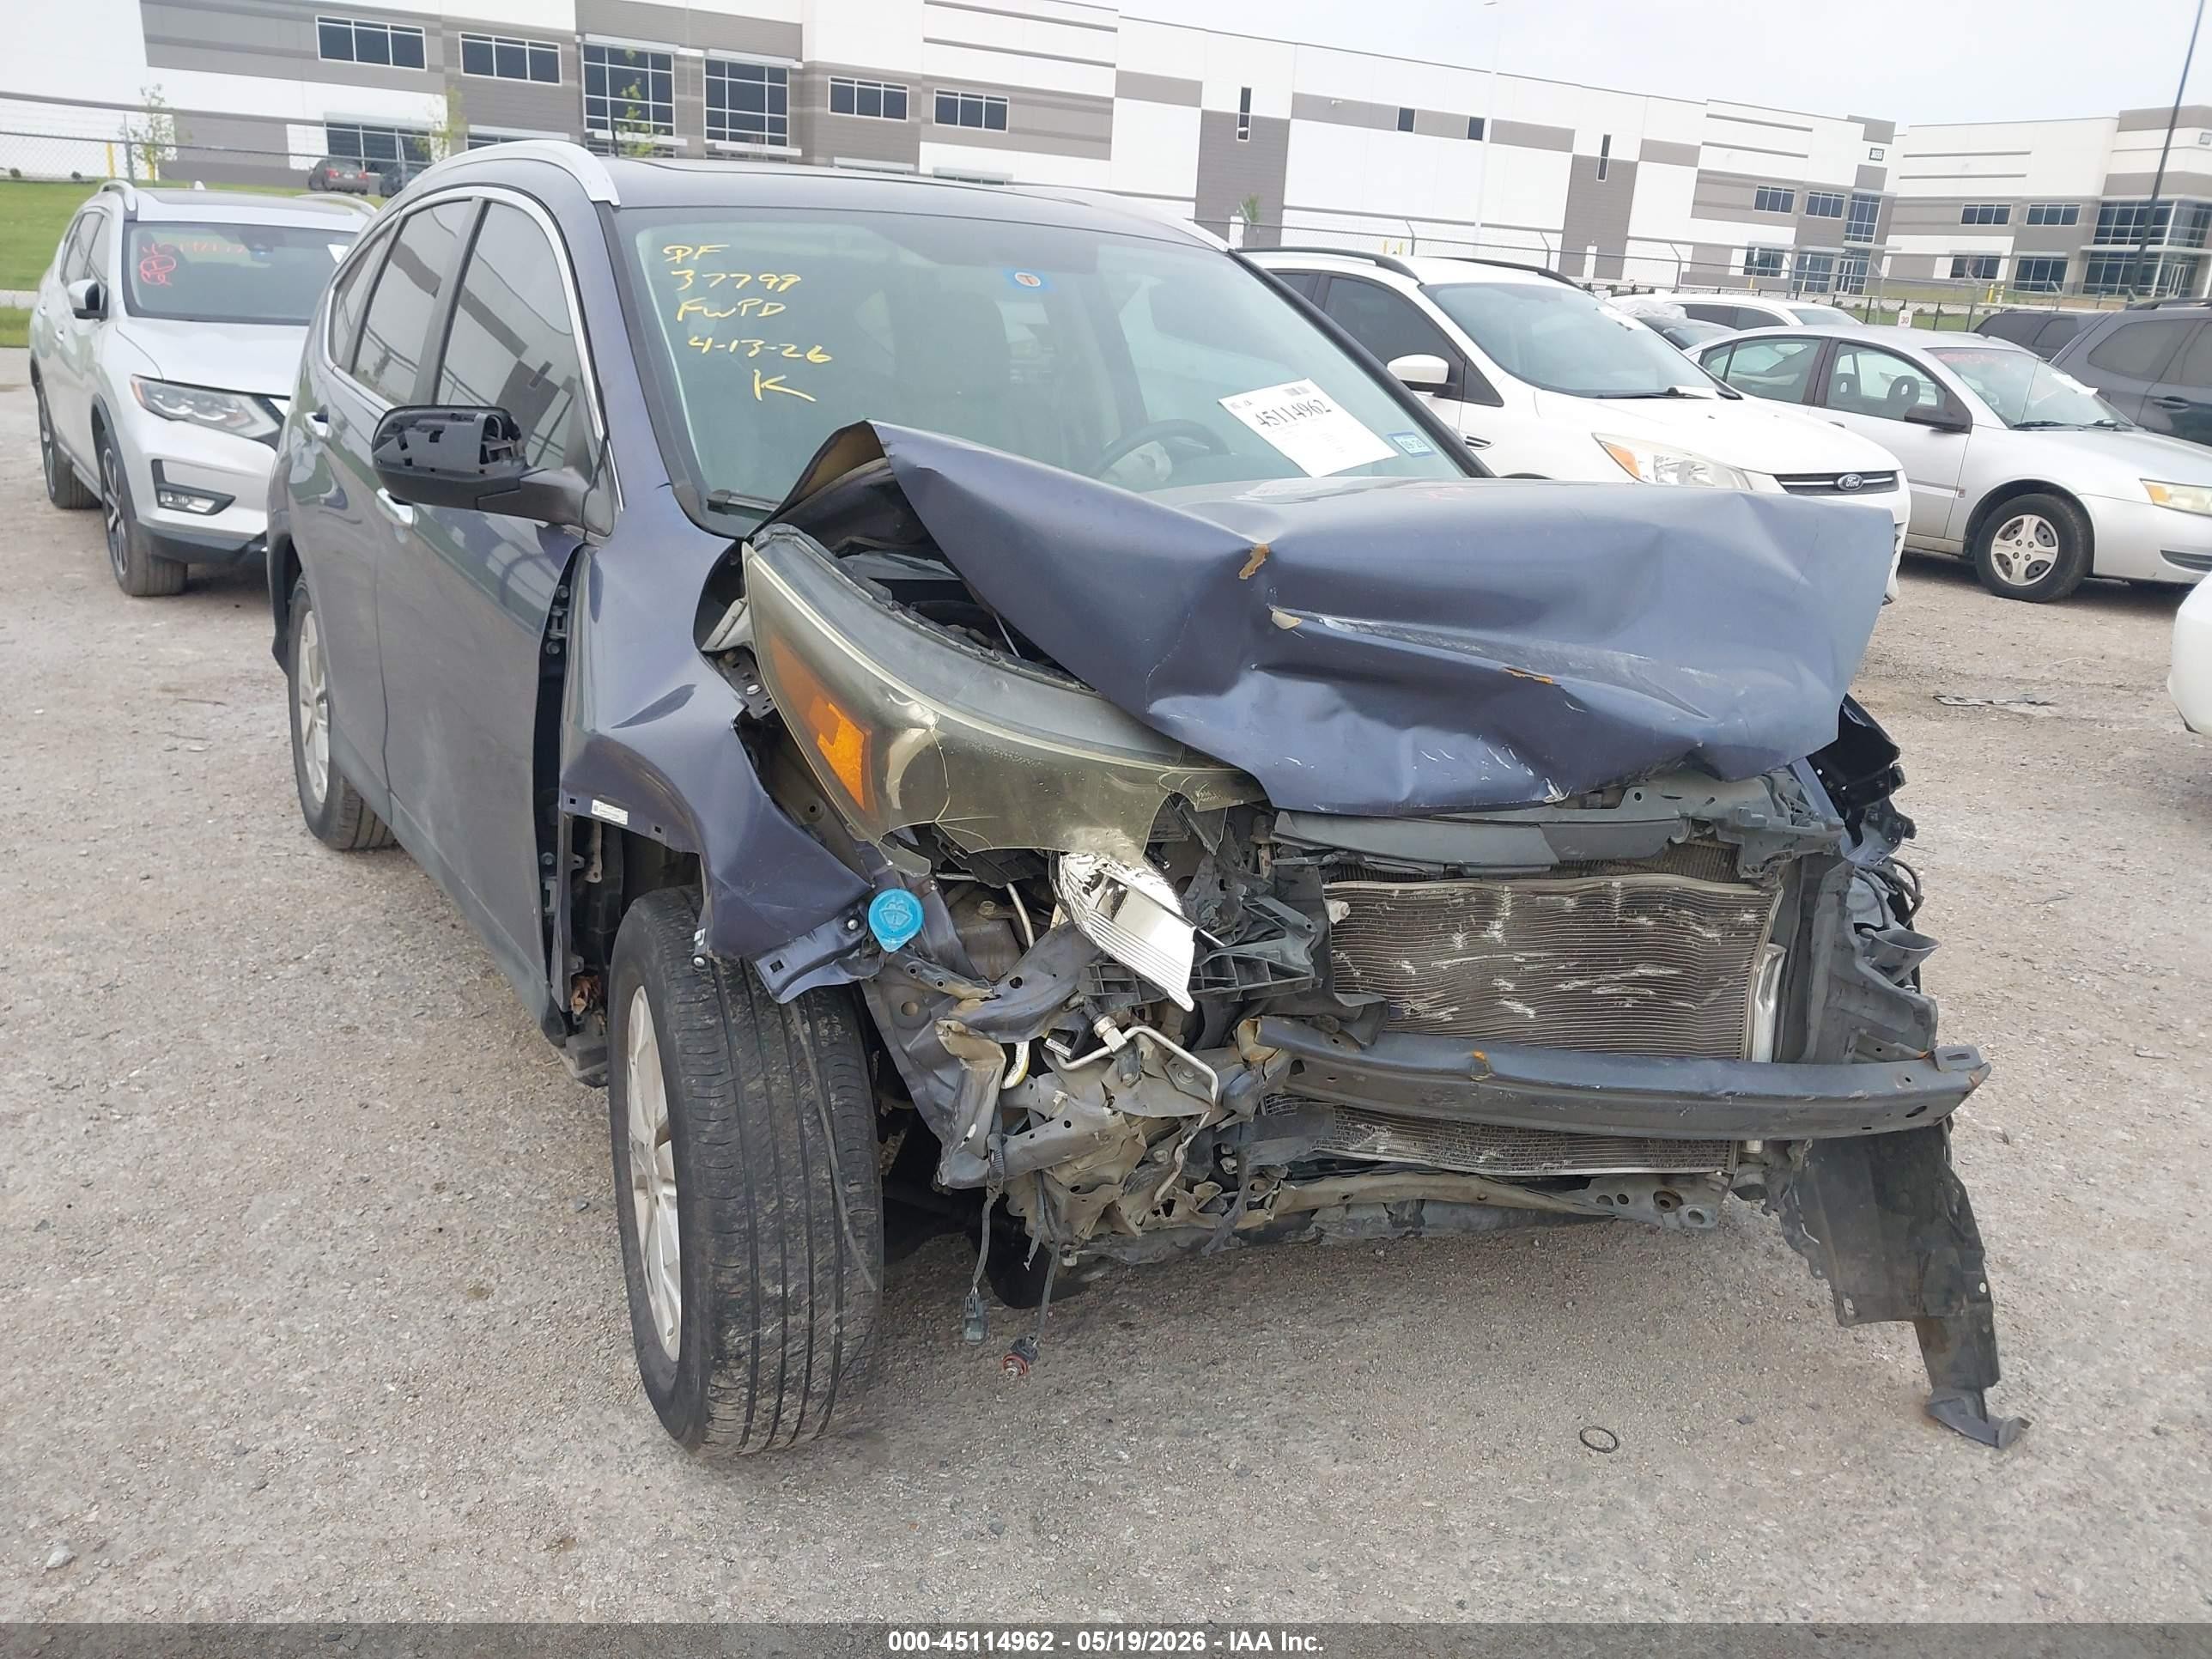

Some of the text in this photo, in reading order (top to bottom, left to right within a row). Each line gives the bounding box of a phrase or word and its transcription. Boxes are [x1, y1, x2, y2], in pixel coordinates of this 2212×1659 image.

[688, 336, 833, 364] 4-13-26
[753, 369, 817, 402] K
[1255, 399, 1332, 427] 45114962
[1846, 477, 1860, 487] Ford
